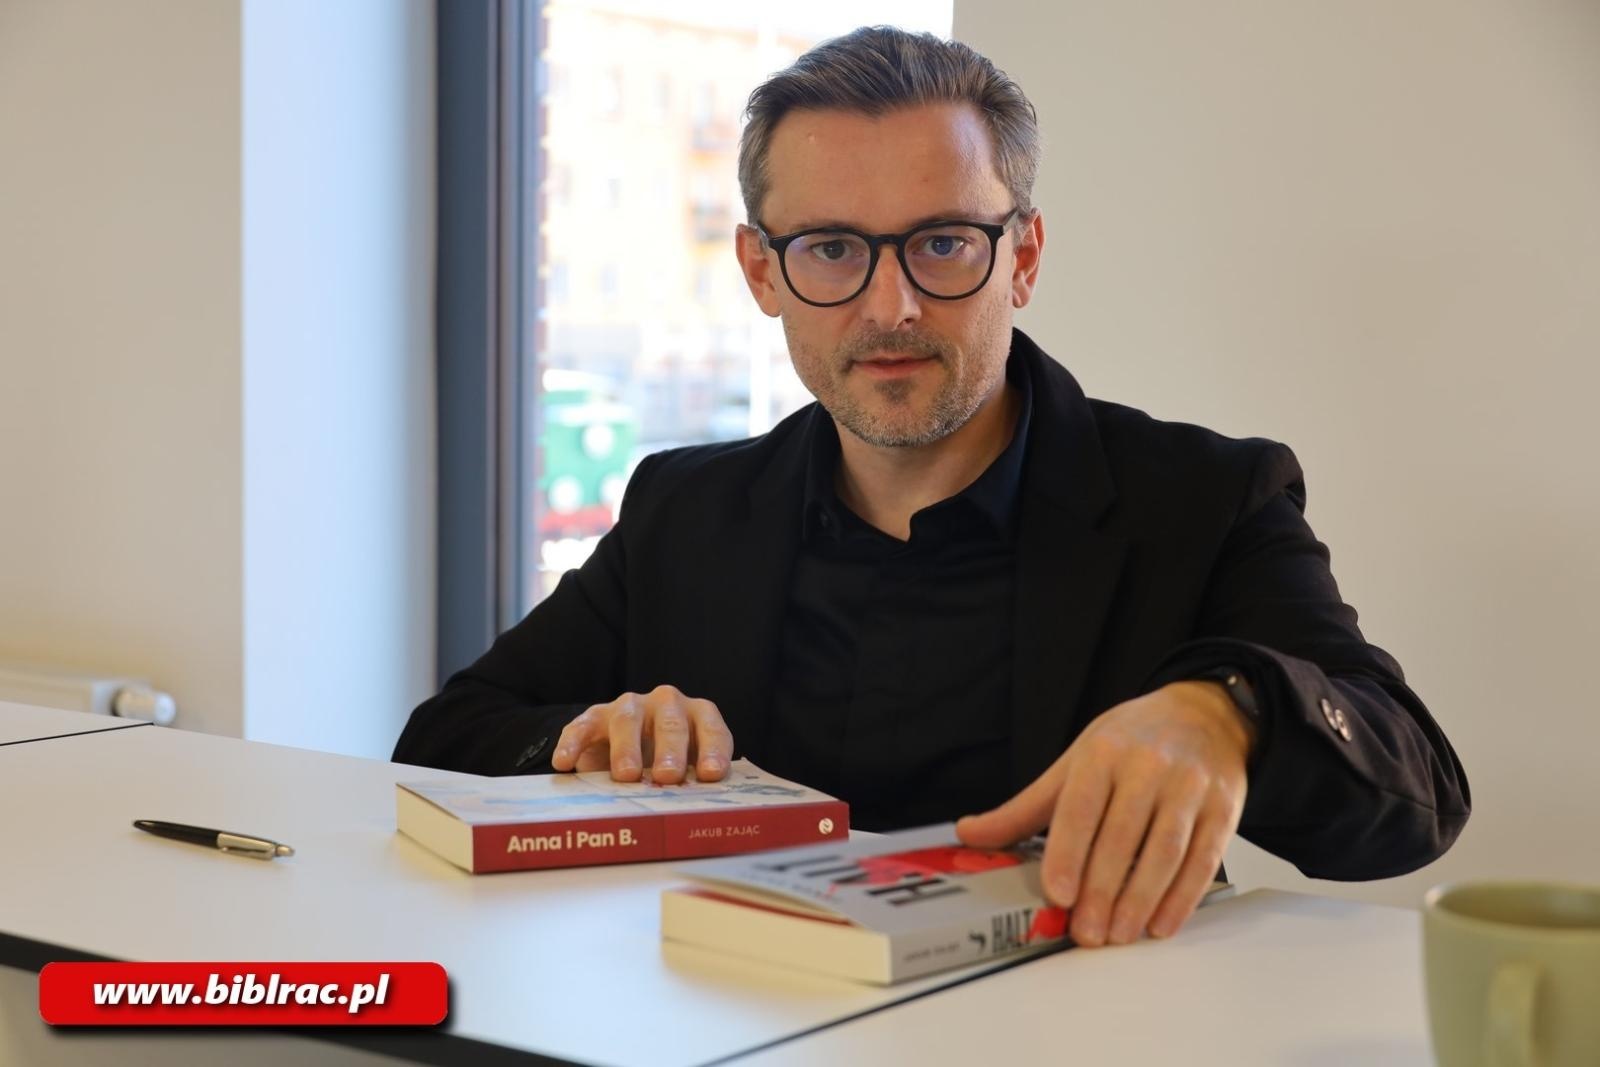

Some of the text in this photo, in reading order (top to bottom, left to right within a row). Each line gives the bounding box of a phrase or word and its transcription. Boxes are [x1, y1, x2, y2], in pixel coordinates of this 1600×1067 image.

[507, 828, 638, 853] Anna i Pan B.
[688, 825, 761, 839] JAKUB ZAJĄC
